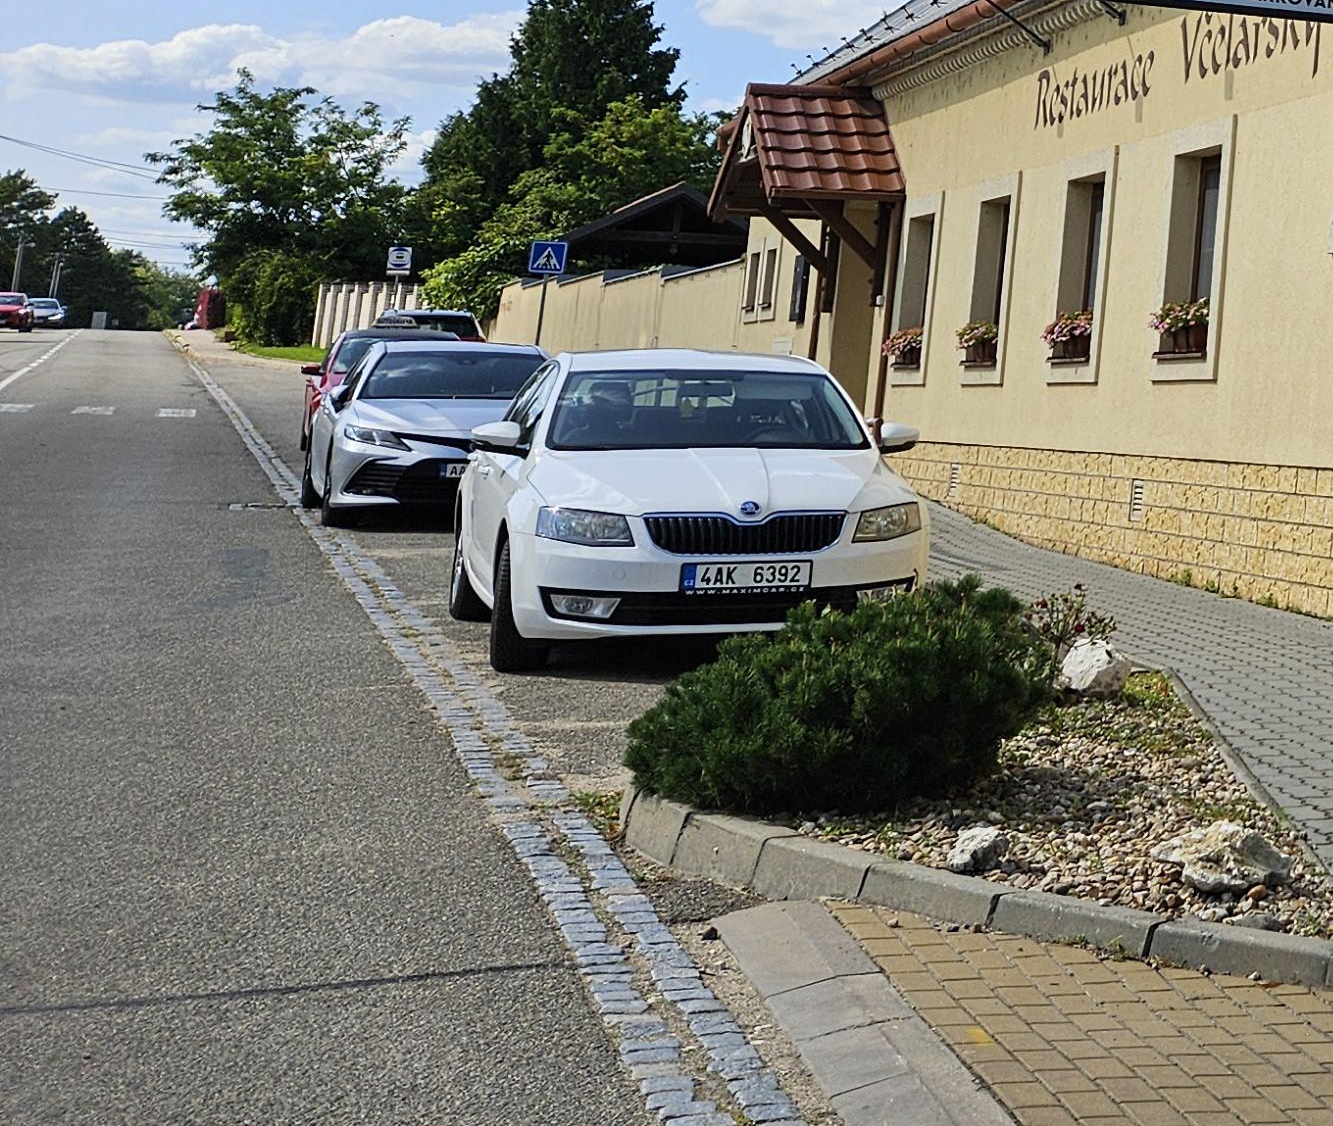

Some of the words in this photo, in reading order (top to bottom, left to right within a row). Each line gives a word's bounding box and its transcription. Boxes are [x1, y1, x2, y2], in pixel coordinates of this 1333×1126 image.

[1033, 50, 1155, 131] Restaurace
[700, 566, 738, 586] 4AK
[752, 565, 801, 584] 6392
